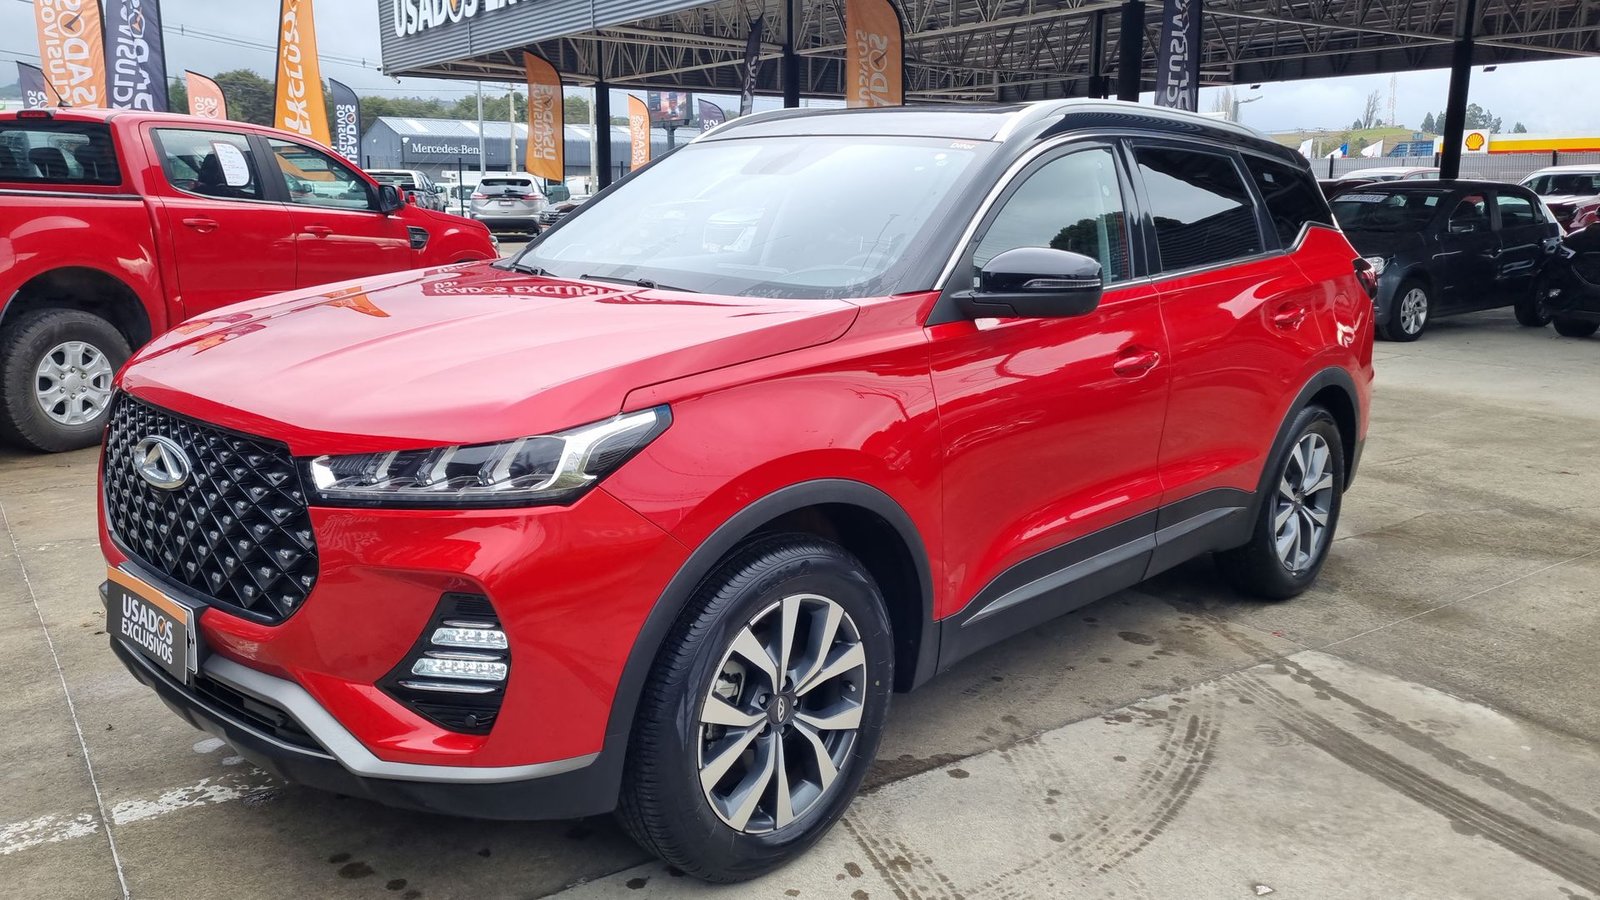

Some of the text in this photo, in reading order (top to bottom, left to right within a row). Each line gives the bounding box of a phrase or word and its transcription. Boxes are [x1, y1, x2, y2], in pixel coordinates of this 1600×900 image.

[411, 143, 481, 155] Mercedes-Ben
[121, 617, 173, 664] EXCLUSIVOS
[122, 594, 173, 645] USADOS
